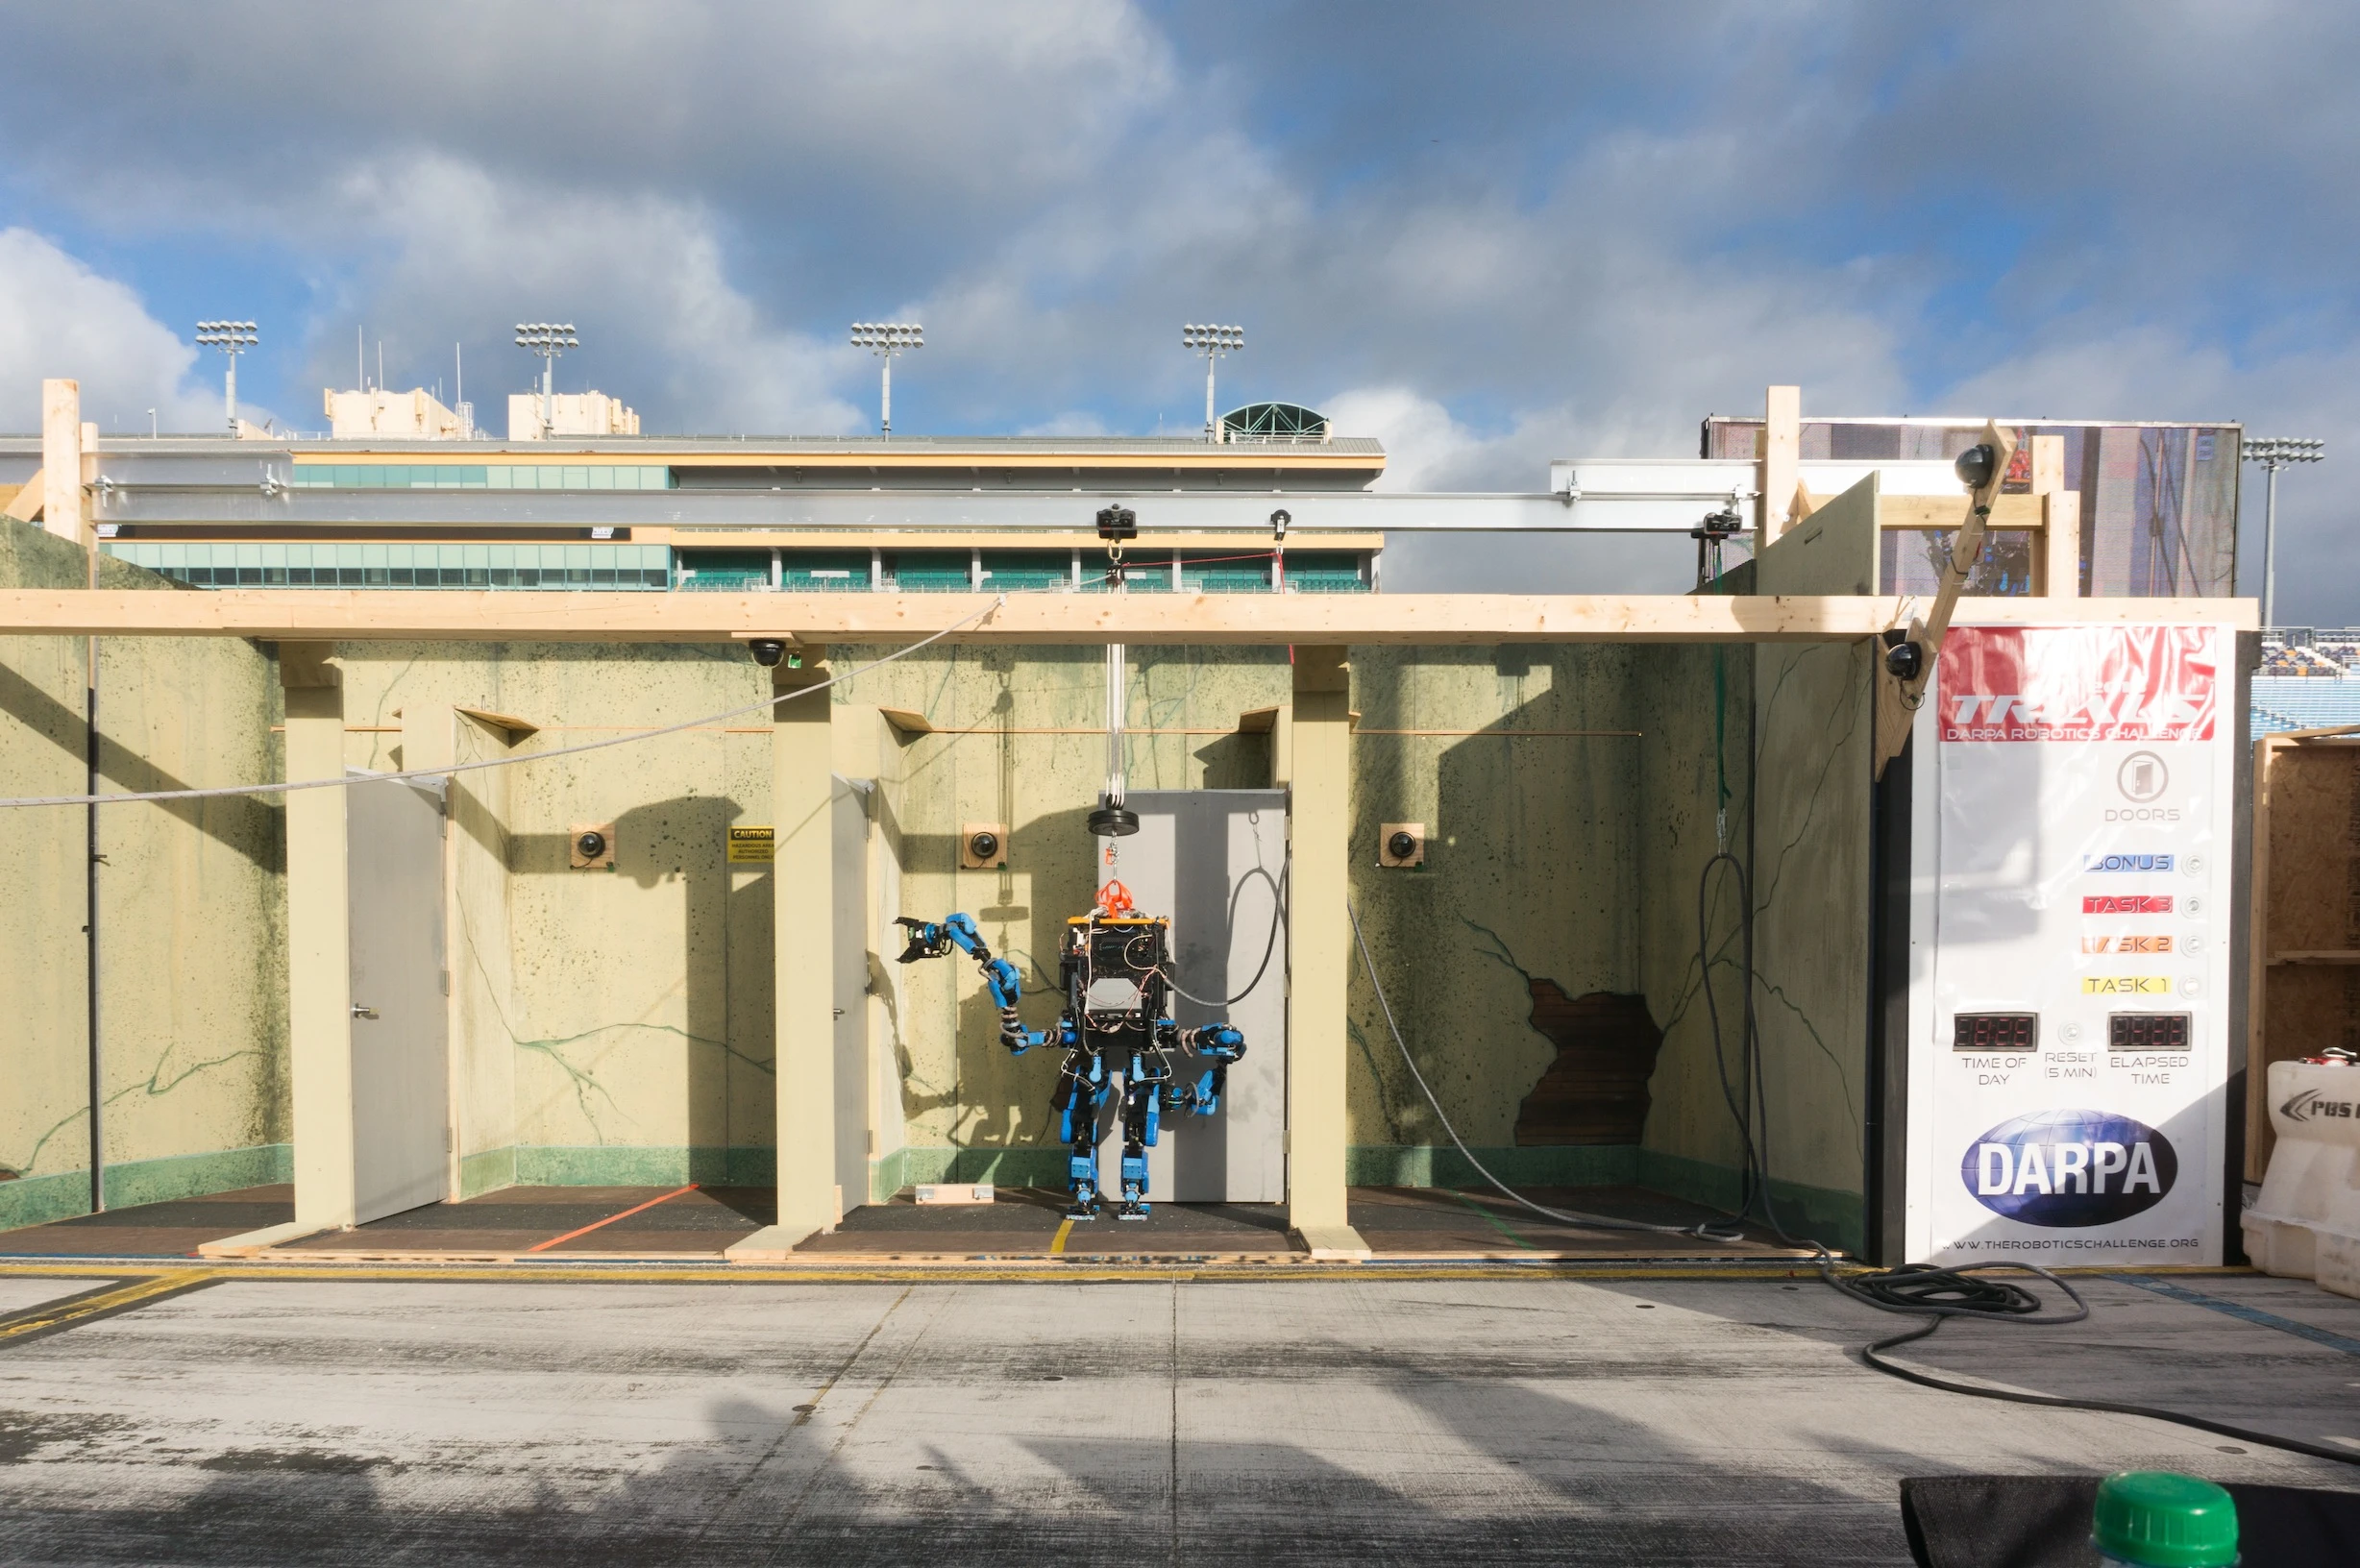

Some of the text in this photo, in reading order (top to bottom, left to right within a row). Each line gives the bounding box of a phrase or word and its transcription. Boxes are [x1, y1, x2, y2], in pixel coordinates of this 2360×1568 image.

[1952, 695, 2206, 724] TRALS
[1947, 728, 2007, 740] DARPA
[2011, 728, 2102, 740] ROBOTICS
[2104, 808, 2180, 821] DOORS
[733, 830, 772, 839] CAUTION
[2088, 897, 2172, 913] TASK 3
[2157, 937, 2170, 952] 2
[2087, 978, 2167, 992] TASK 1
[1961, 1057, 2027, 1068] TIME OF
[2045, 1052, 2097, 1062] RESET
[2110, 1057, 2189, 1067] ELAPSED
[2063, 1067, 2098, 1078] MIN)
[2131, 1073, 2170, 1084] TIME
[1979, 1074, 2009, 1086] DAY
[1978, 1141, 2161, 1195] DARPA
